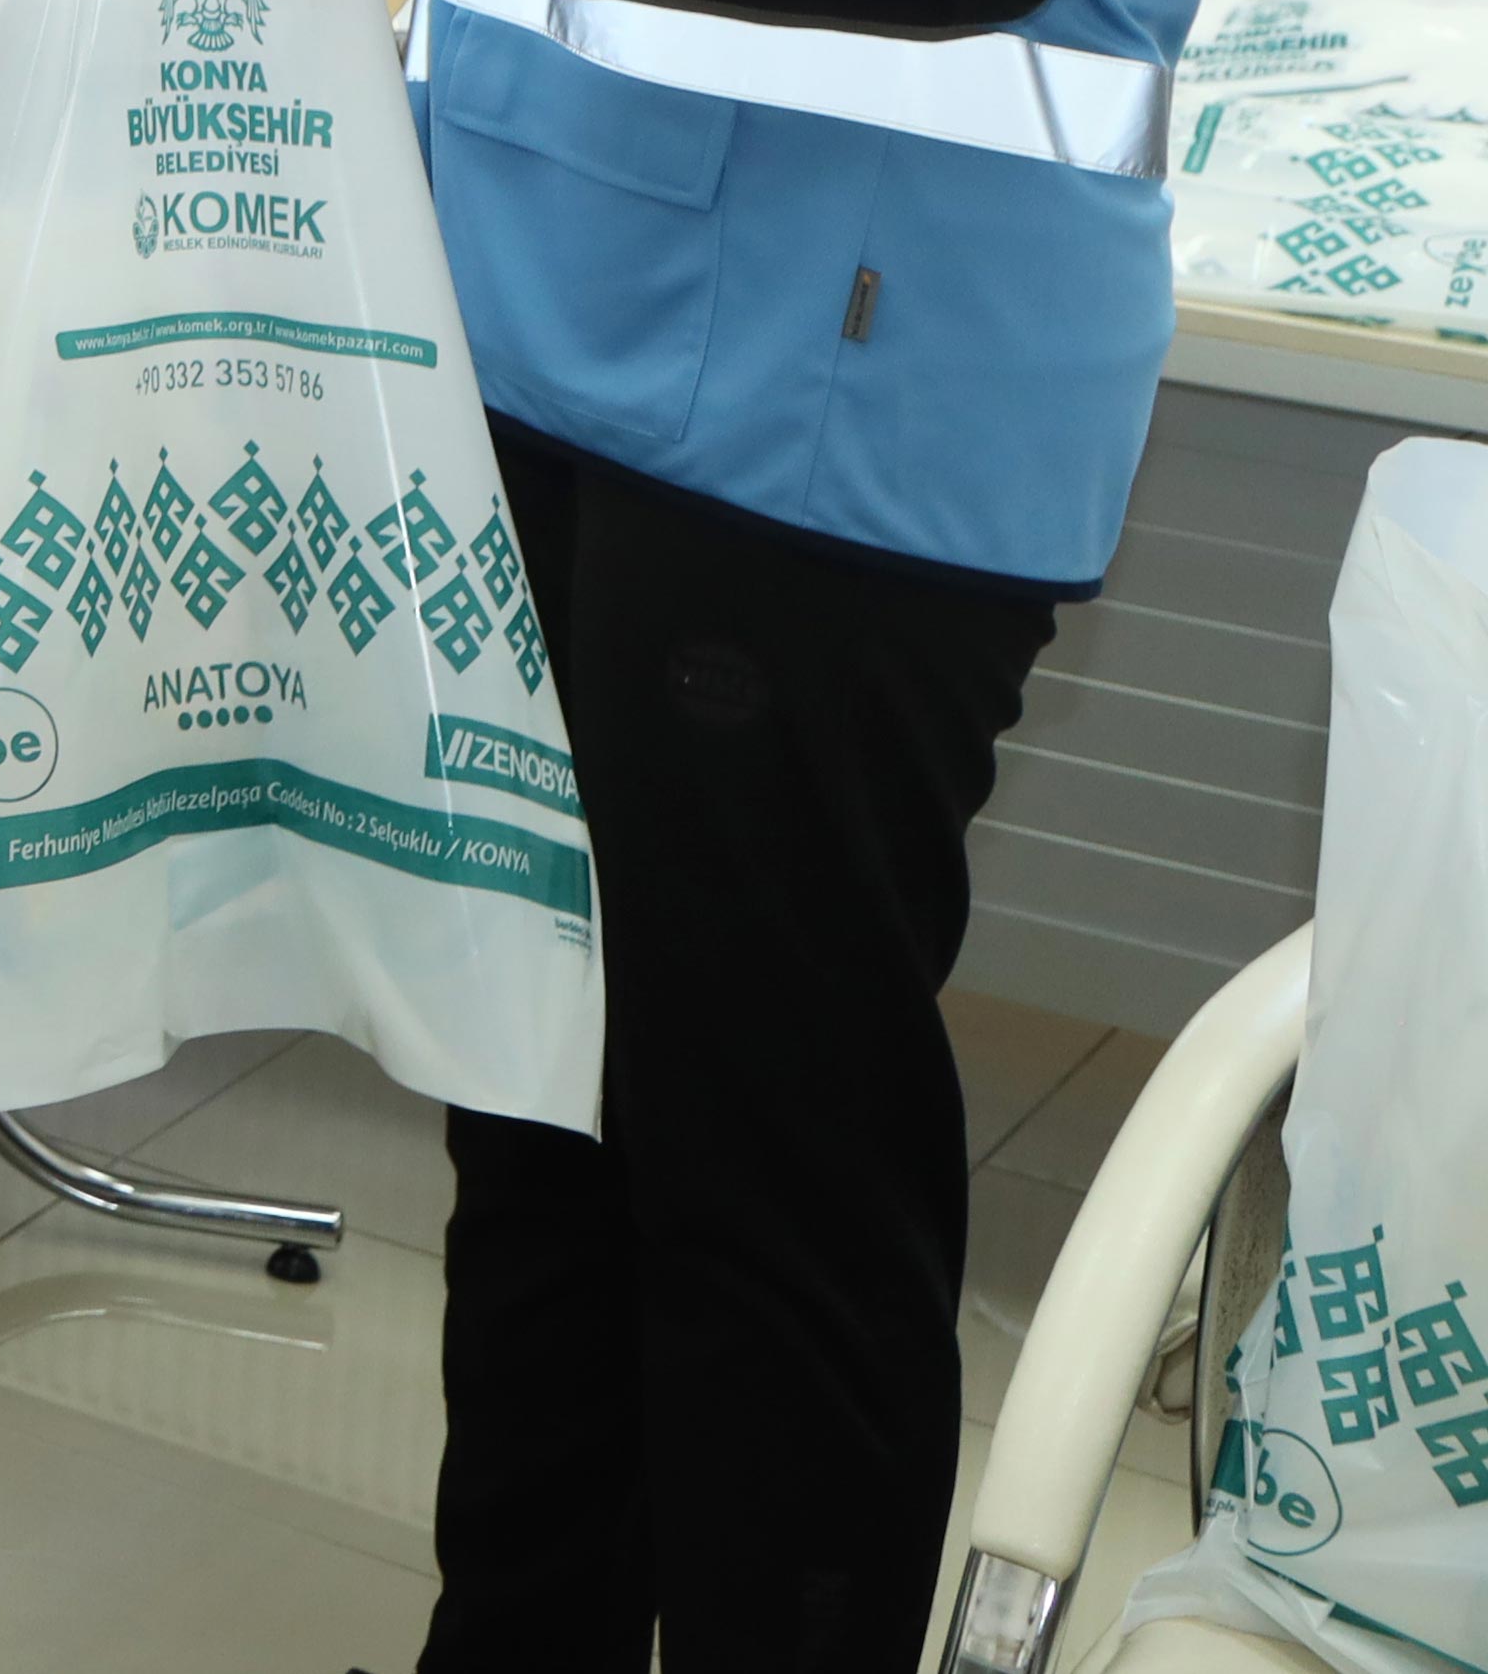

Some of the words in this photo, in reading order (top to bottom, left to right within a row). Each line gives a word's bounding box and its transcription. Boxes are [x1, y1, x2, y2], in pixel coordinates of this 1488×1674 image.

[161, 60, 267, 92] KONYA
[127, 94, 333, 149] BÜYÜKŞEHİR
[156, 144, 279, 176] BELEDİYESİ
[163, 190, 328, 244] KOMEK
[166, 359, 203, 393] 332
[215, 357, 269, 388] 353
[276, 362, 294, 395] 57
[300, 370, 324, 401] 86
[143, 660, 307, 713] ANATOYA
[8, 827, 101, 864] Ferhuniye
[267, 780, 321, 816] Caddesi
[369, 815, 440, 857] Selçuklu
[463, 841, 531, 876] KONYA
